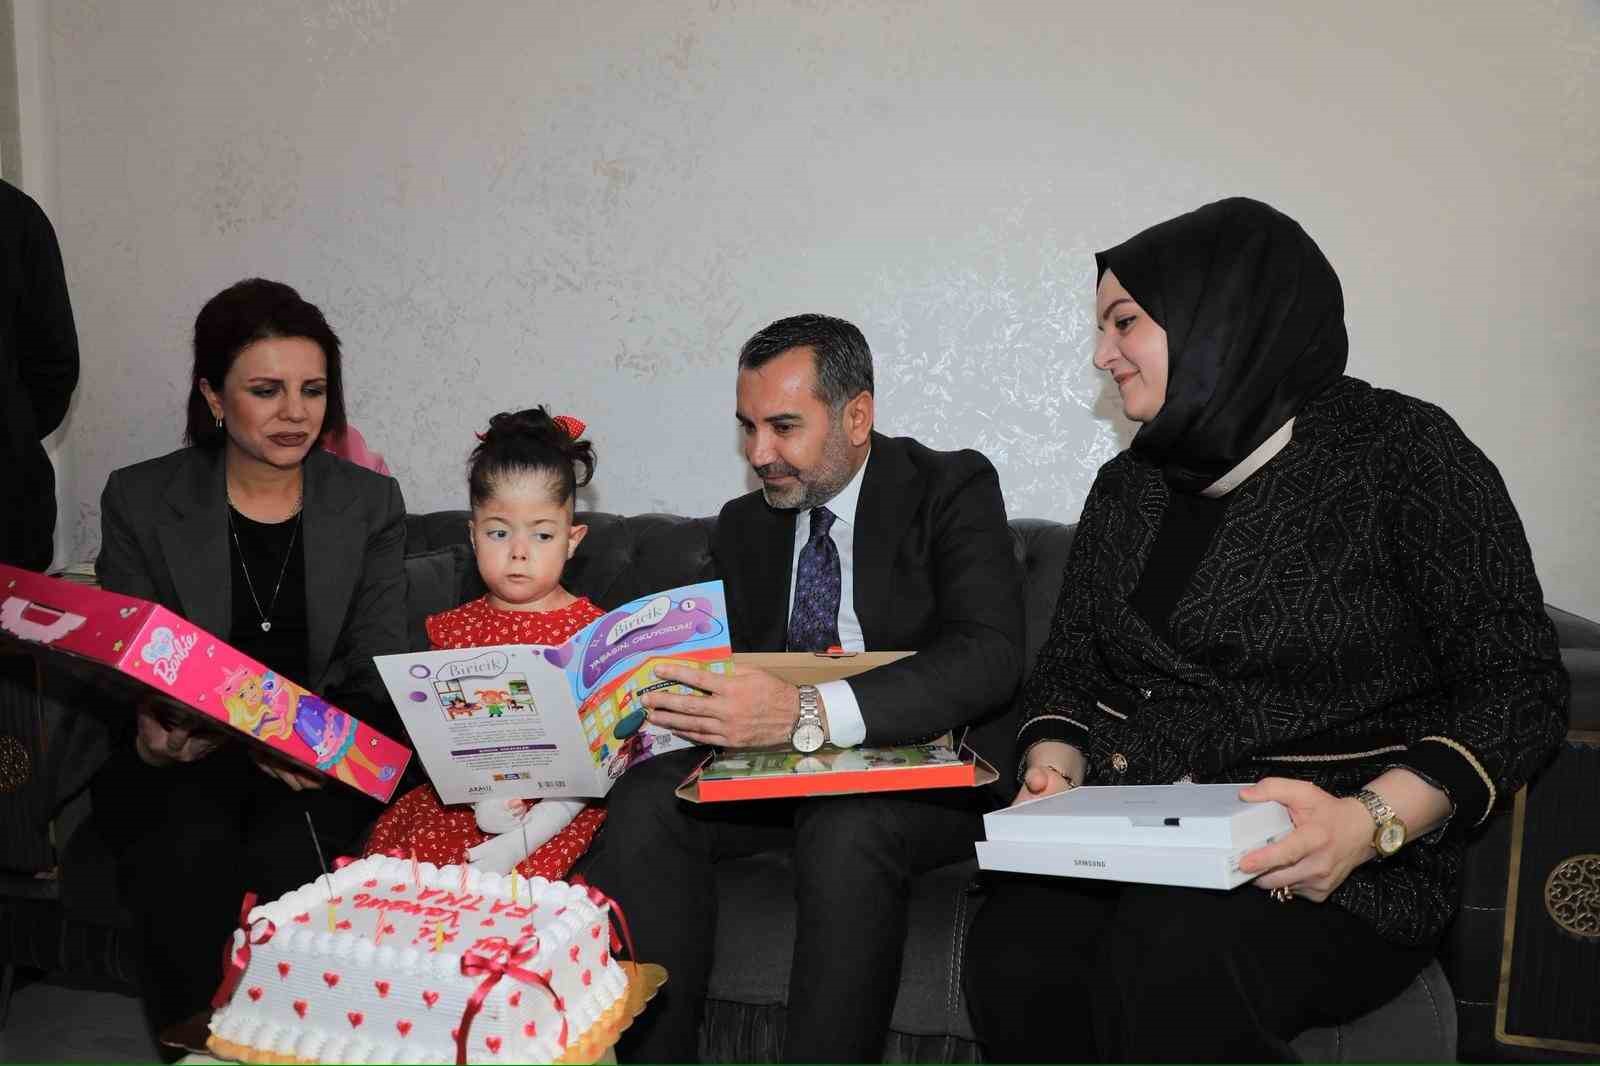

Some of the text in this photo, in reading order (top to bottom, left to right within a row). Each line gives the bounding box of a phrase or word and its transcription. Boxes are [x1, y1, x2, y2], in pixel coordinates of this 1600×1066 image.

[615, 604, 663, 637] Biricik
[153, 632, 199, 685] Barbie
[449, 657, 502, 678] Biricik
[1073, 858, 1107, 869] SAMSUNG
